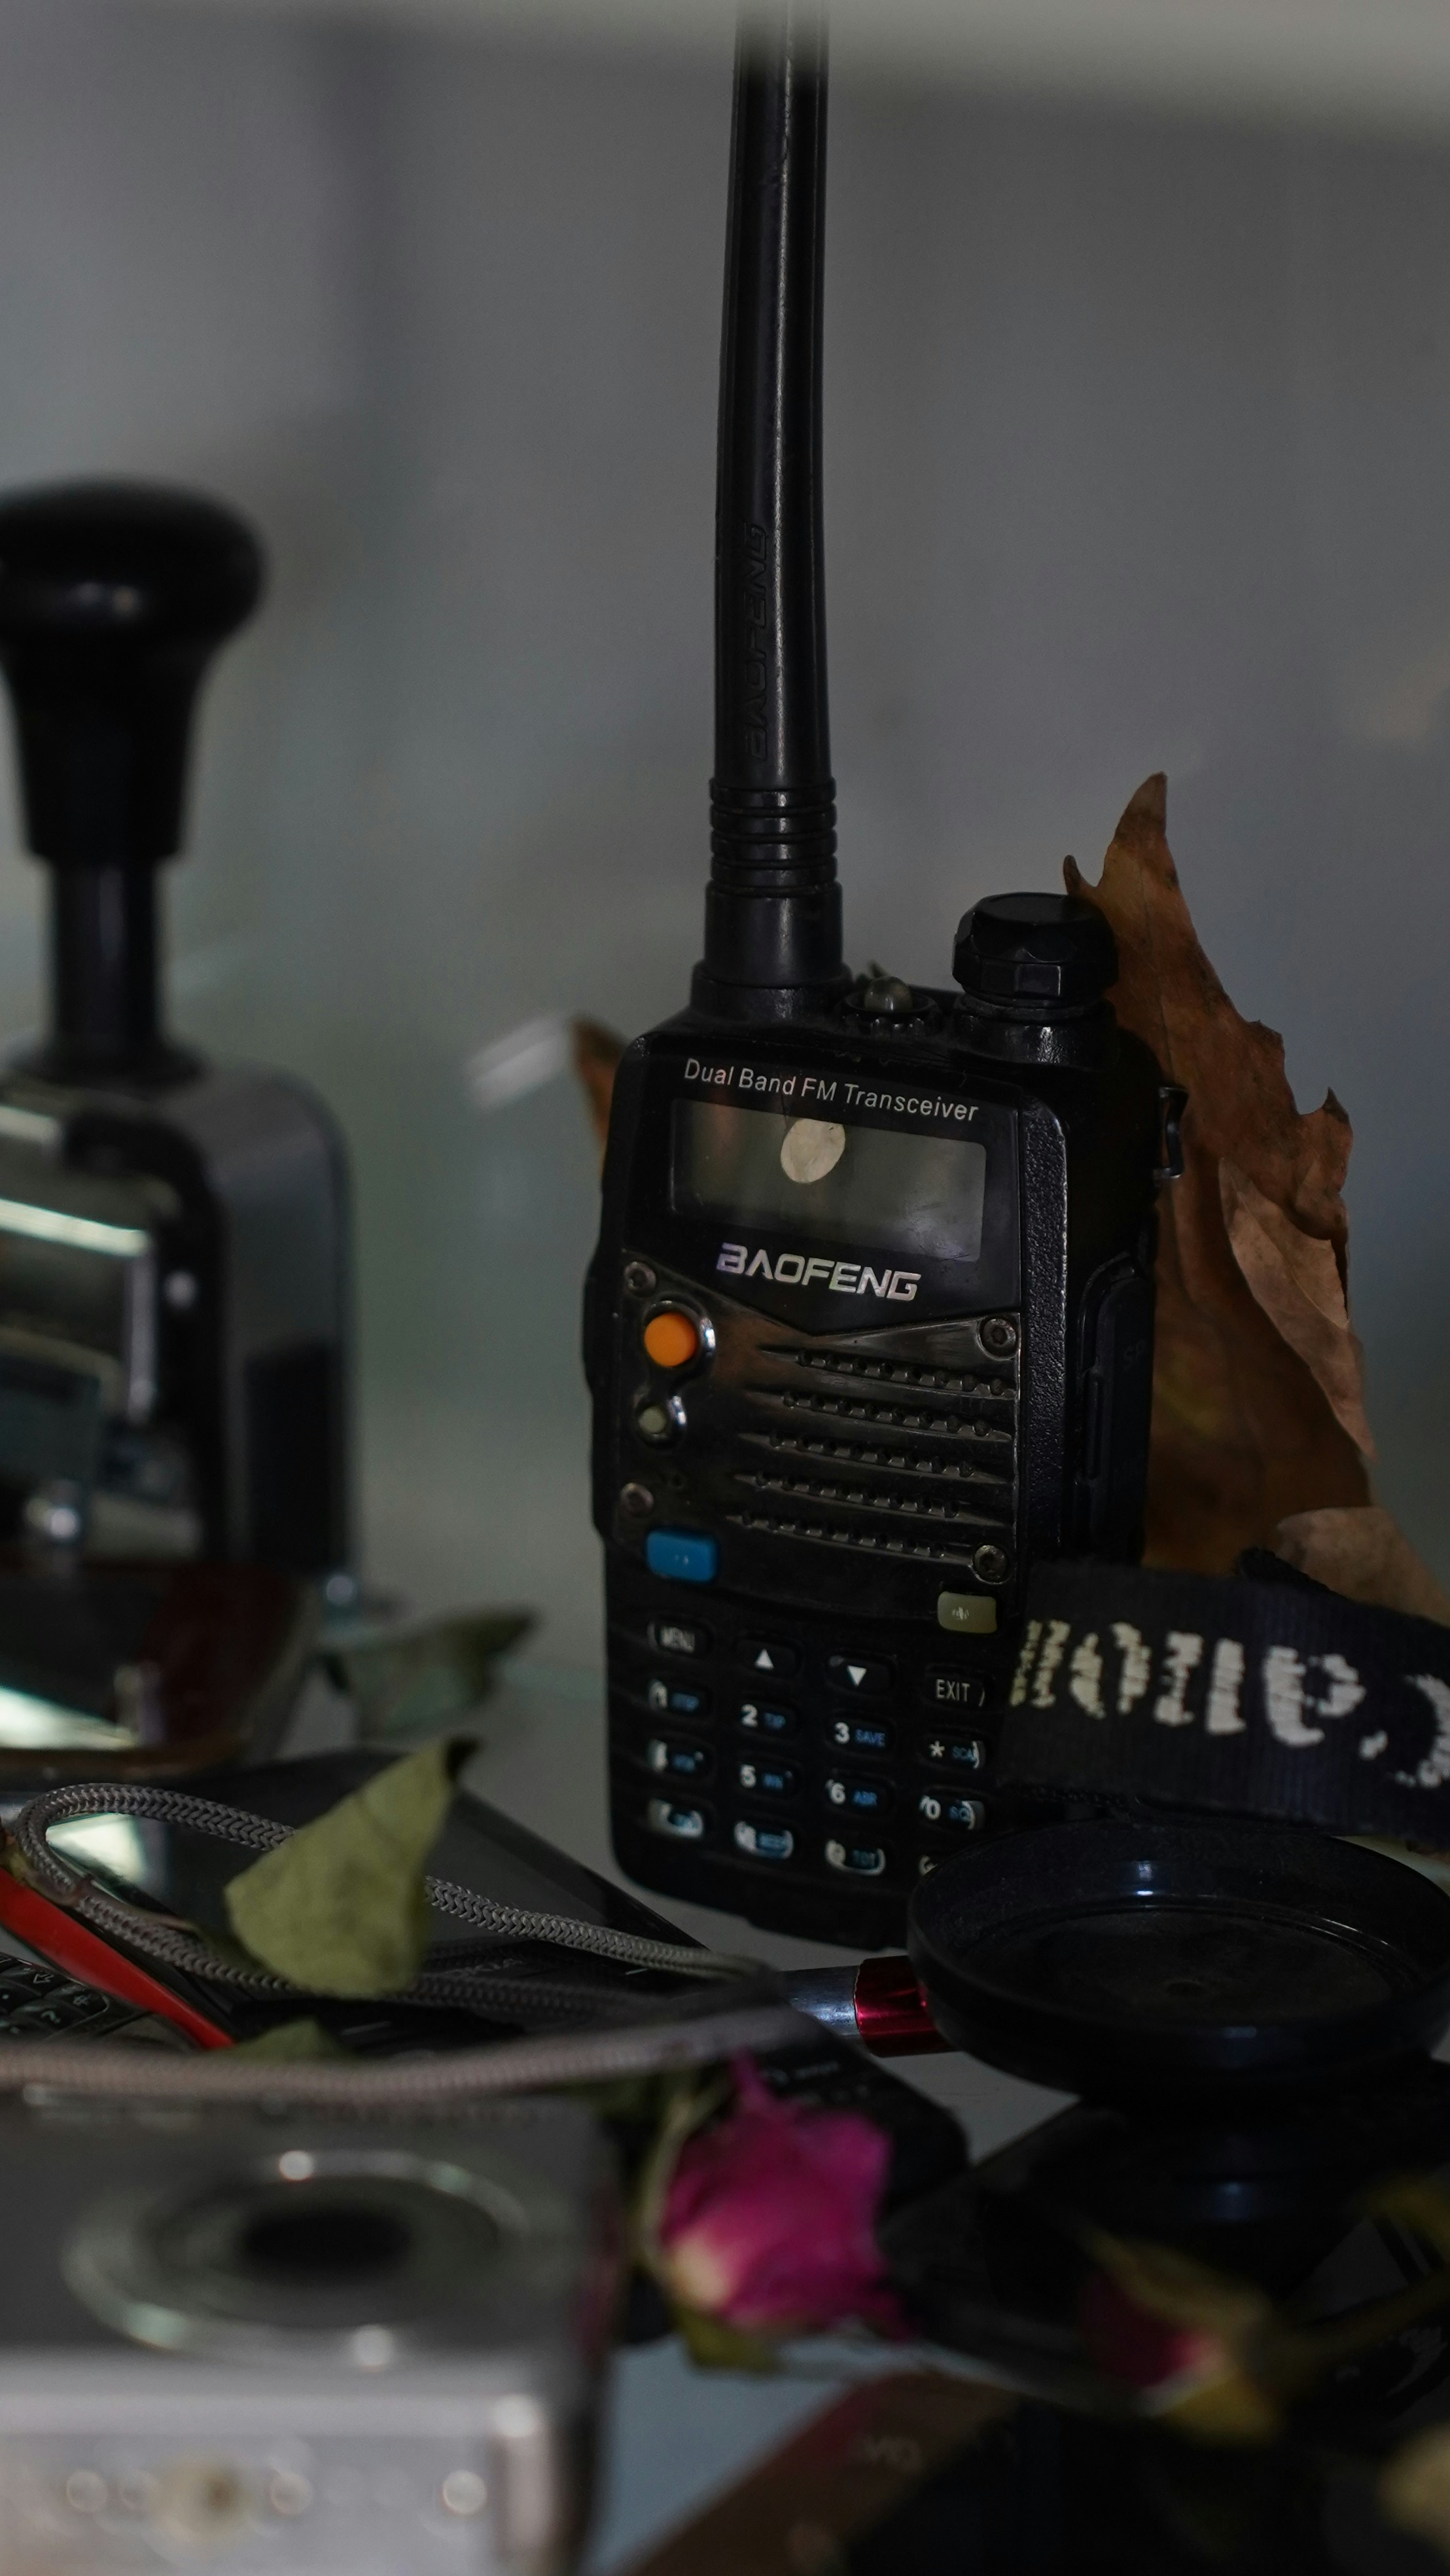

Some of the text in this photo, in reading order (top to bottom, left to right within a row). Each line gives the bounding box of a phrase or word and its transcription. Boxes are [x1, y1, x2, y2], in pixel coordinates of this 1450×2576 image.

[743, 523, 768, 762] BAOFENG
[684, 1058, 979, 1122] Dual Band FM Transceiver
[716, 1242, 921, 1302] BAOFENG
[935, 1679, 970, 1703] EXIT
[740, 1704, 758, 1728] 2
[834, 1721, 887, 1748] 3 SAVE
[739, 1763, 756, 1789] 5
[828, 1782, 846, 1806] 6
